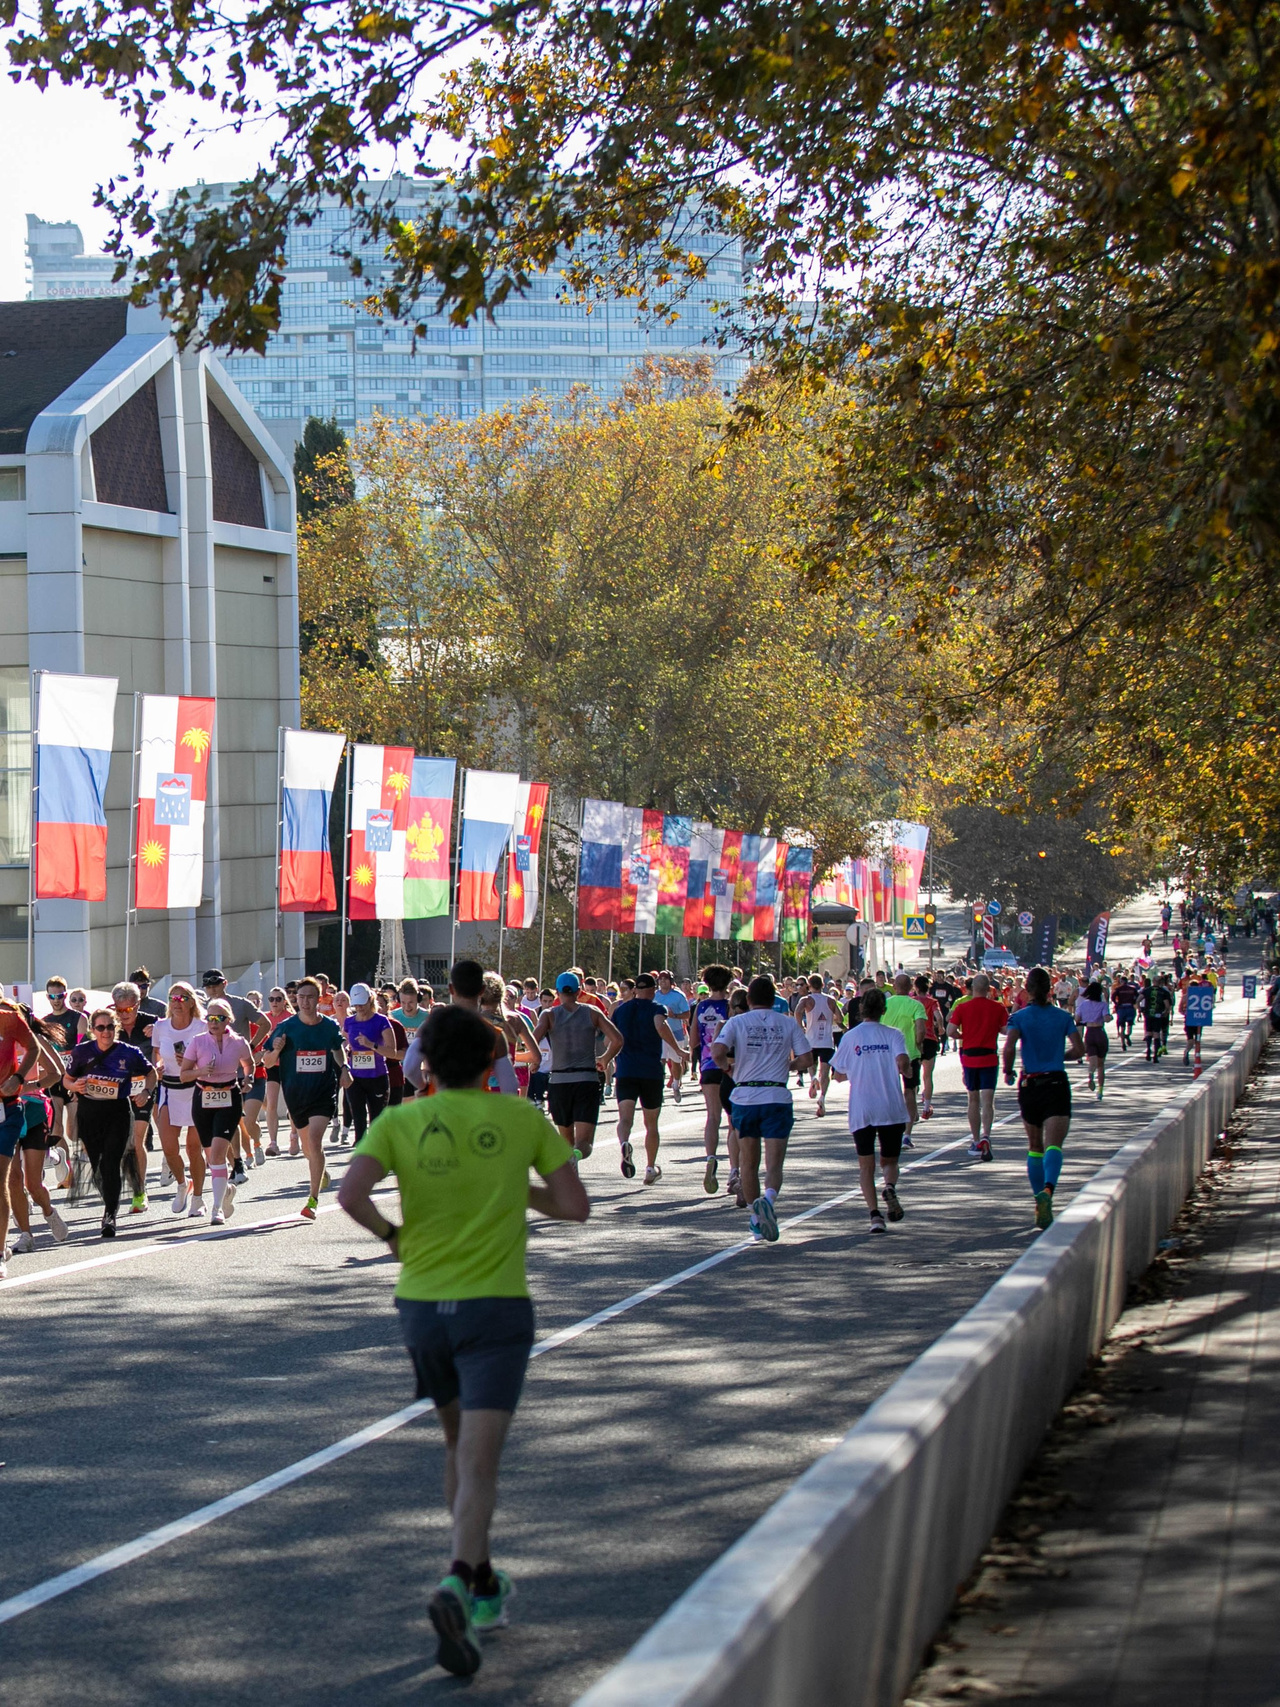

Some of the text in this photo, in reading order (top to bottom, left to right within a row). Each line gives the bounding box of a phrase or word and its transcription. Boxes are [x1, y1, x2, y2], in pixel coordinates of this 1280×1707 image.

[1245, 979, 1254, 992] 5
[1188, 995, 1212, 1011] 26
[300, 1057, 323, 1066] 1326
[354, 1055, 372, 1063] 3759
[89, 1084, 115, 1095] 3909
[205, 1091, 227, 1099] 3210
